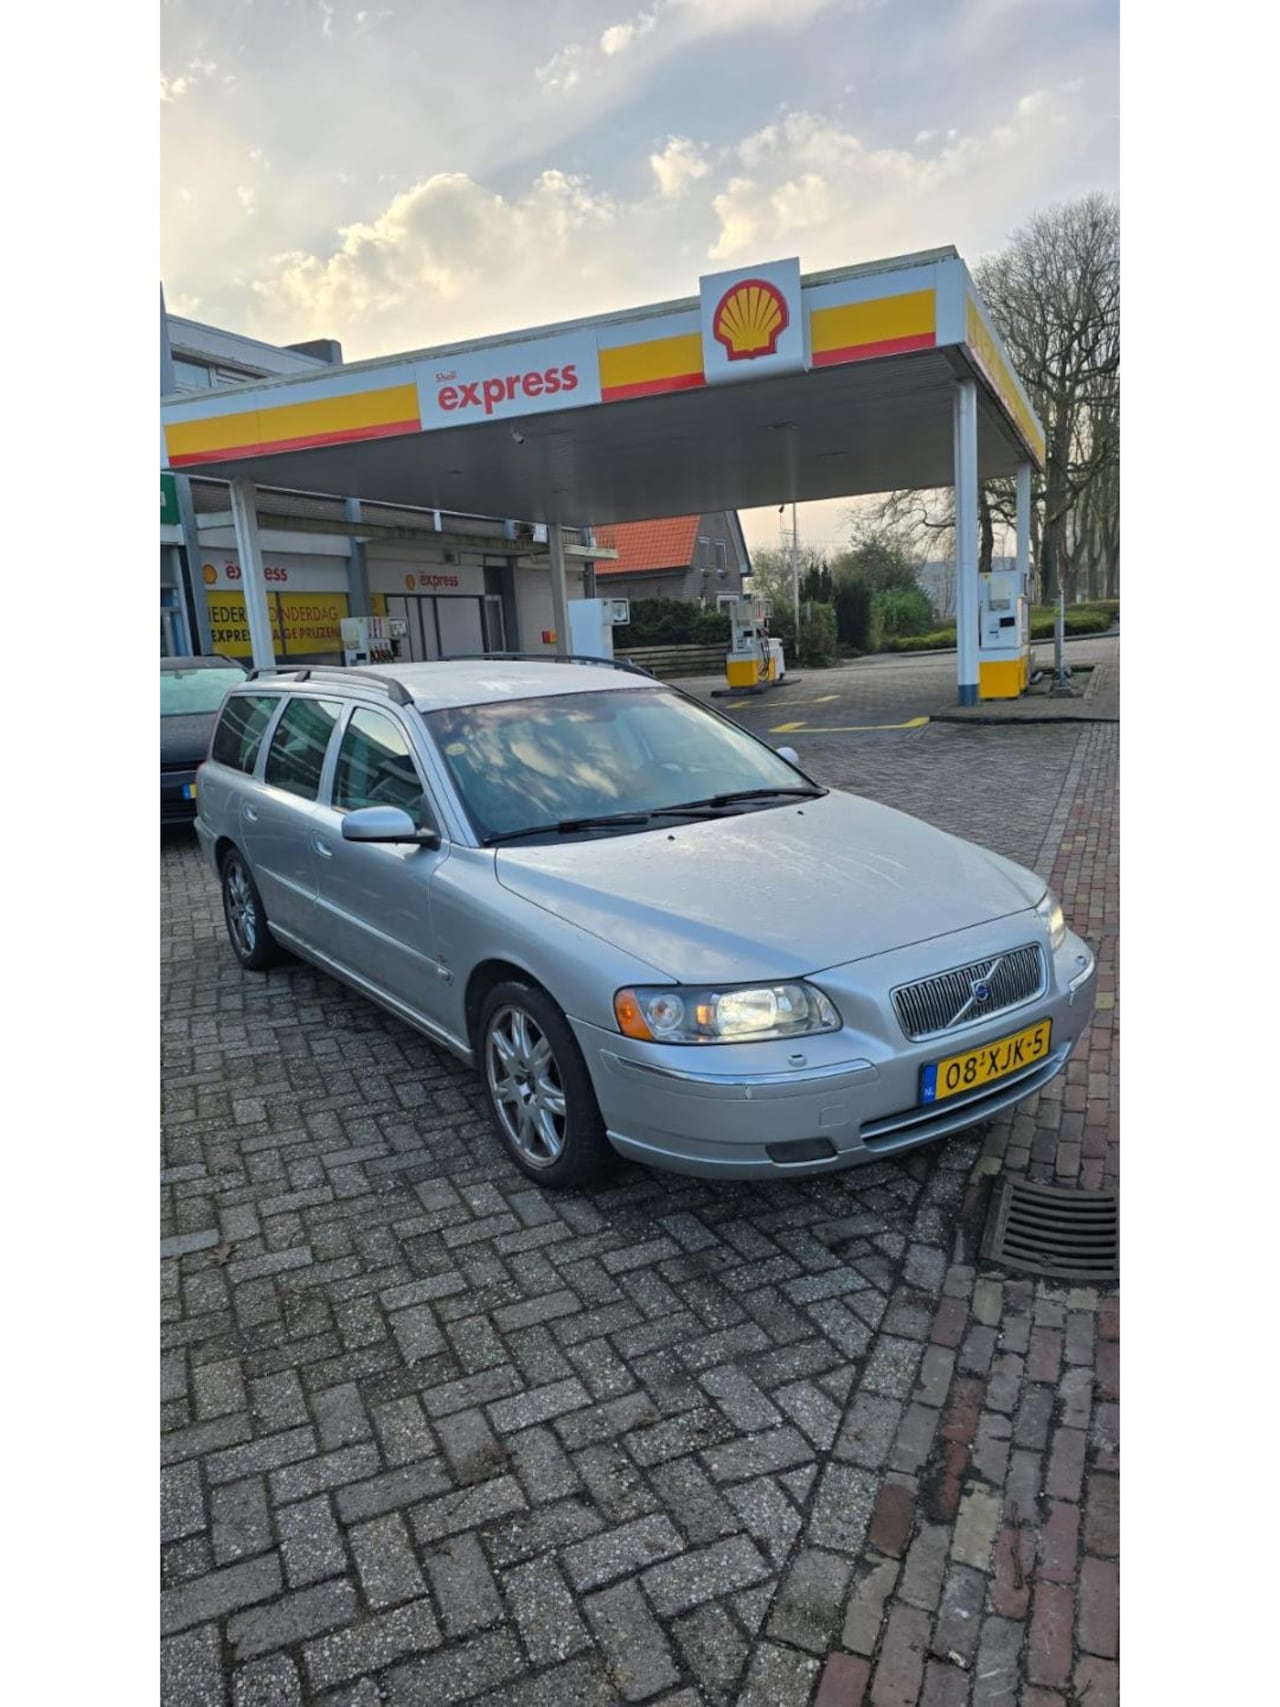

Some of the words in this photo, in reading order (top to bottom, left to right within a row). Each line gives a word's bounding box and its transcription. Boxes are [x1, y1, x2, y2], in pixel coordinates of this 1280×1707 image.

[435, 370, 457, 382] Shell
[438, 364, 578, 414] express
[420, 575, 459, 591] express
